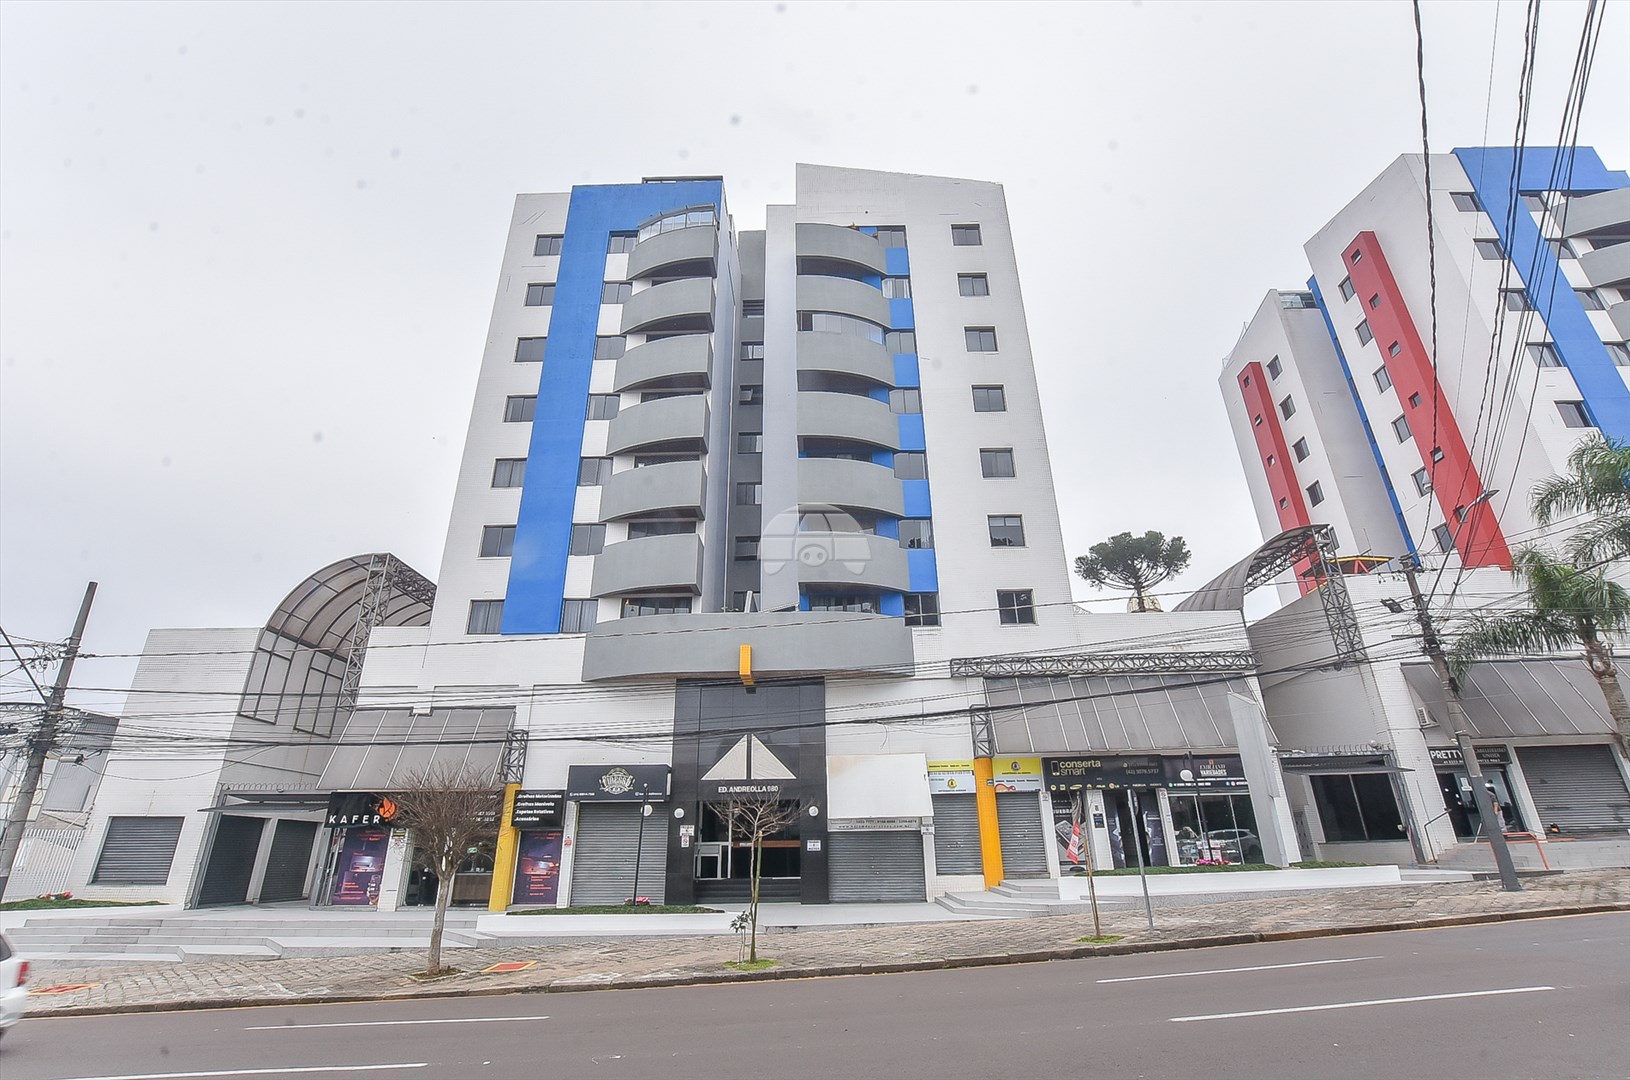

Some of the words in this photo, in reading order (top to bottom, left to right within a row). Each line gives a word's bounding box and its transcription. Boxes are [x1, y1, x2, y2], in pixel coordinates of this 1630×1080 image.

[1059, 759, 1102, 769] conserta
[1060, 767, 1086, 776] smart
[729, 785, 767, 793] ANDREOLLA
[328, 814, 381, 824] KAFER
